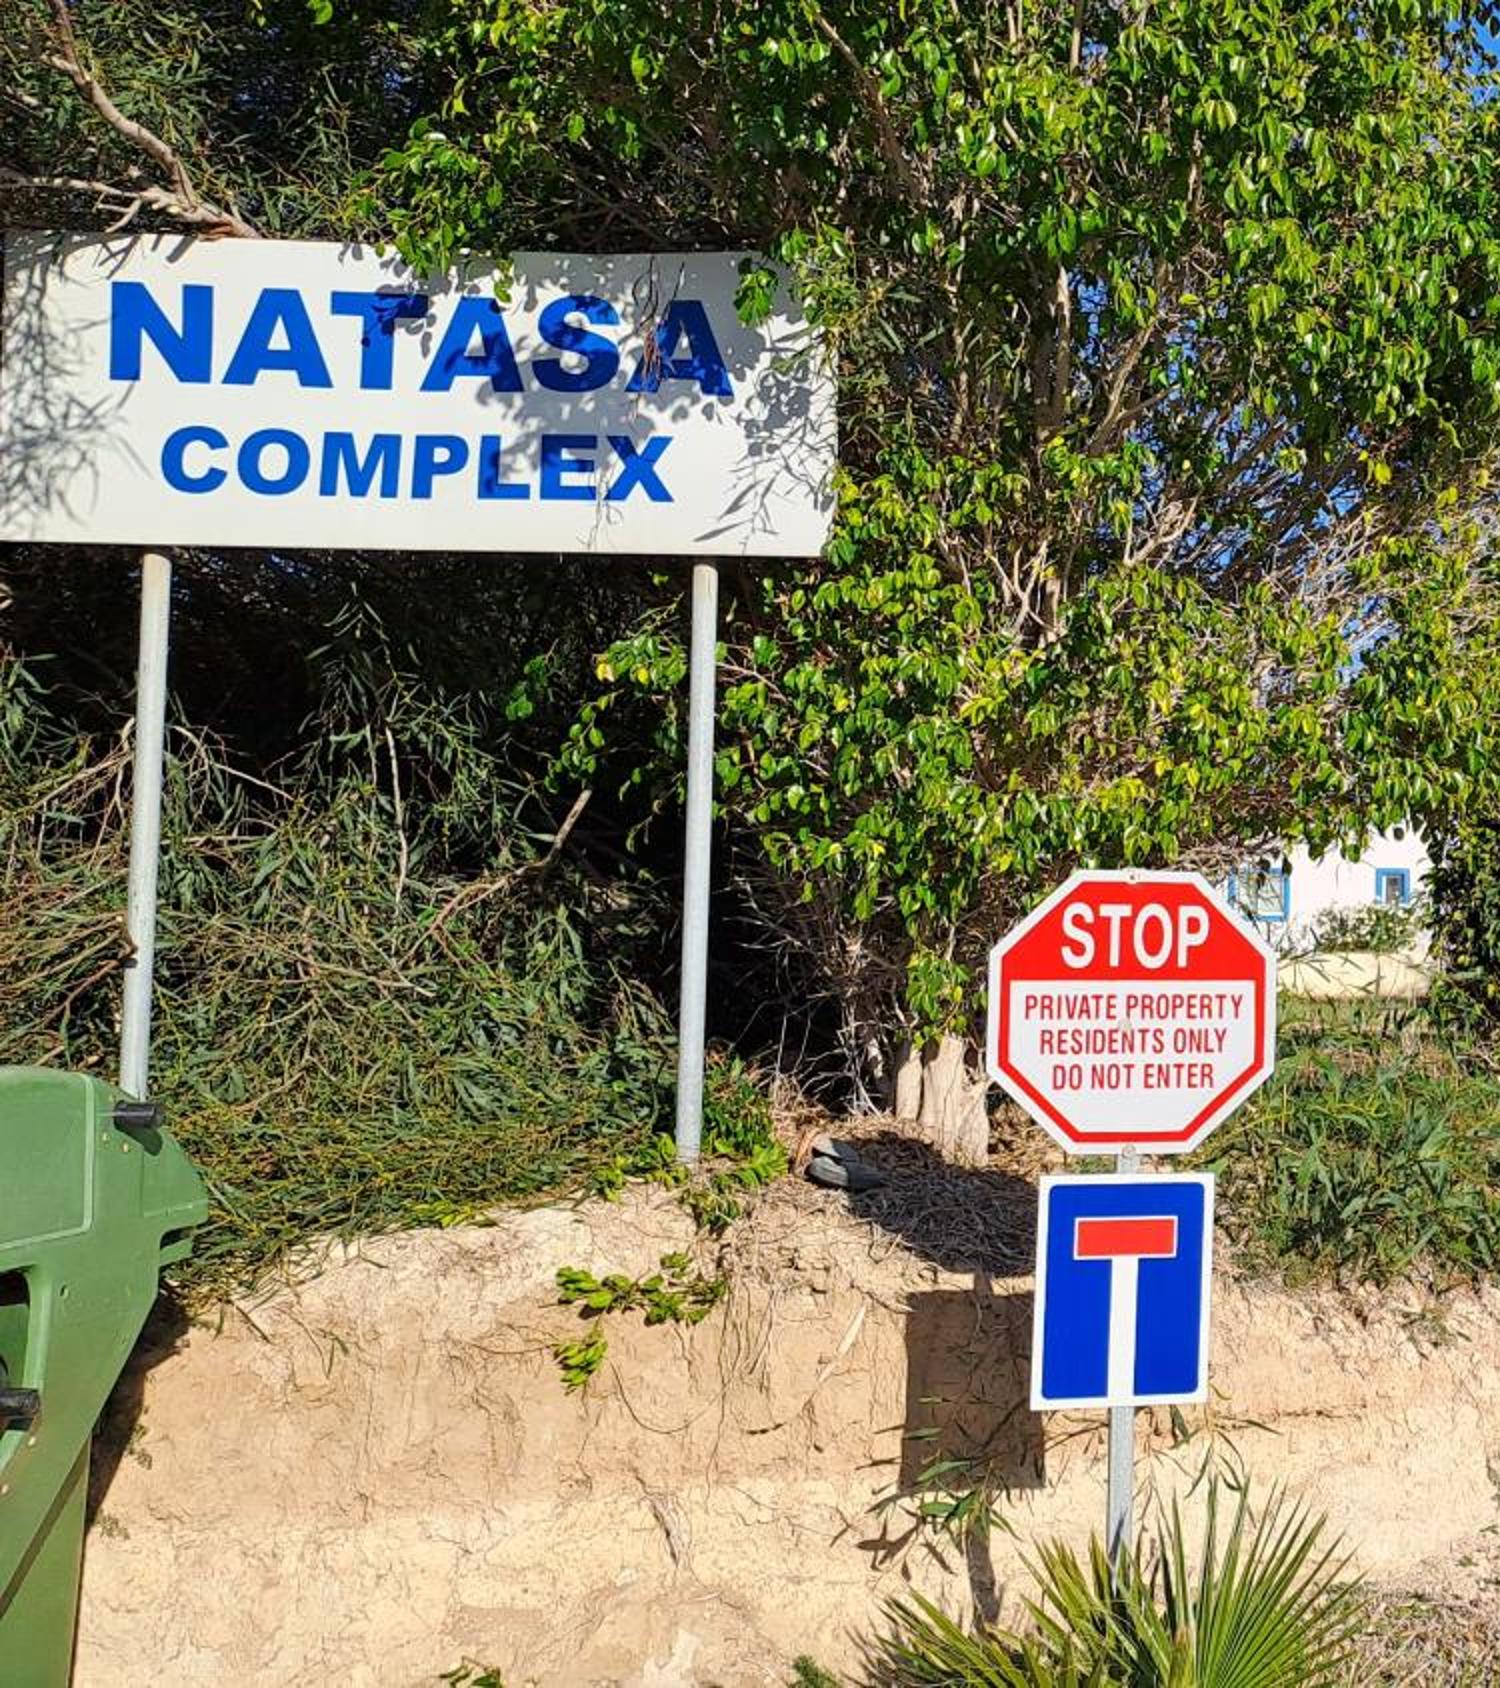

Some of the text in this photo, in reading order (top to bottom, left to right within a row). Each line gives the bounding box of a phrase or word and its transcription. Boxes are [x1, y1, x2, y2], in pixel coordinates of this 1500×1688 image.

[108, 280, 735, 398] NATASA
[159, 425, 675, 504] COMPLEX
[1060, 902, 1211, 969] STOP
[1024, 993, 1244, 1020] PRIVATE PROPERTY
[1039, 1027, 1228, 1055] RESIDENTS ONLY
[1052, 1062, 1214, 1091] DO NOT ENTER
